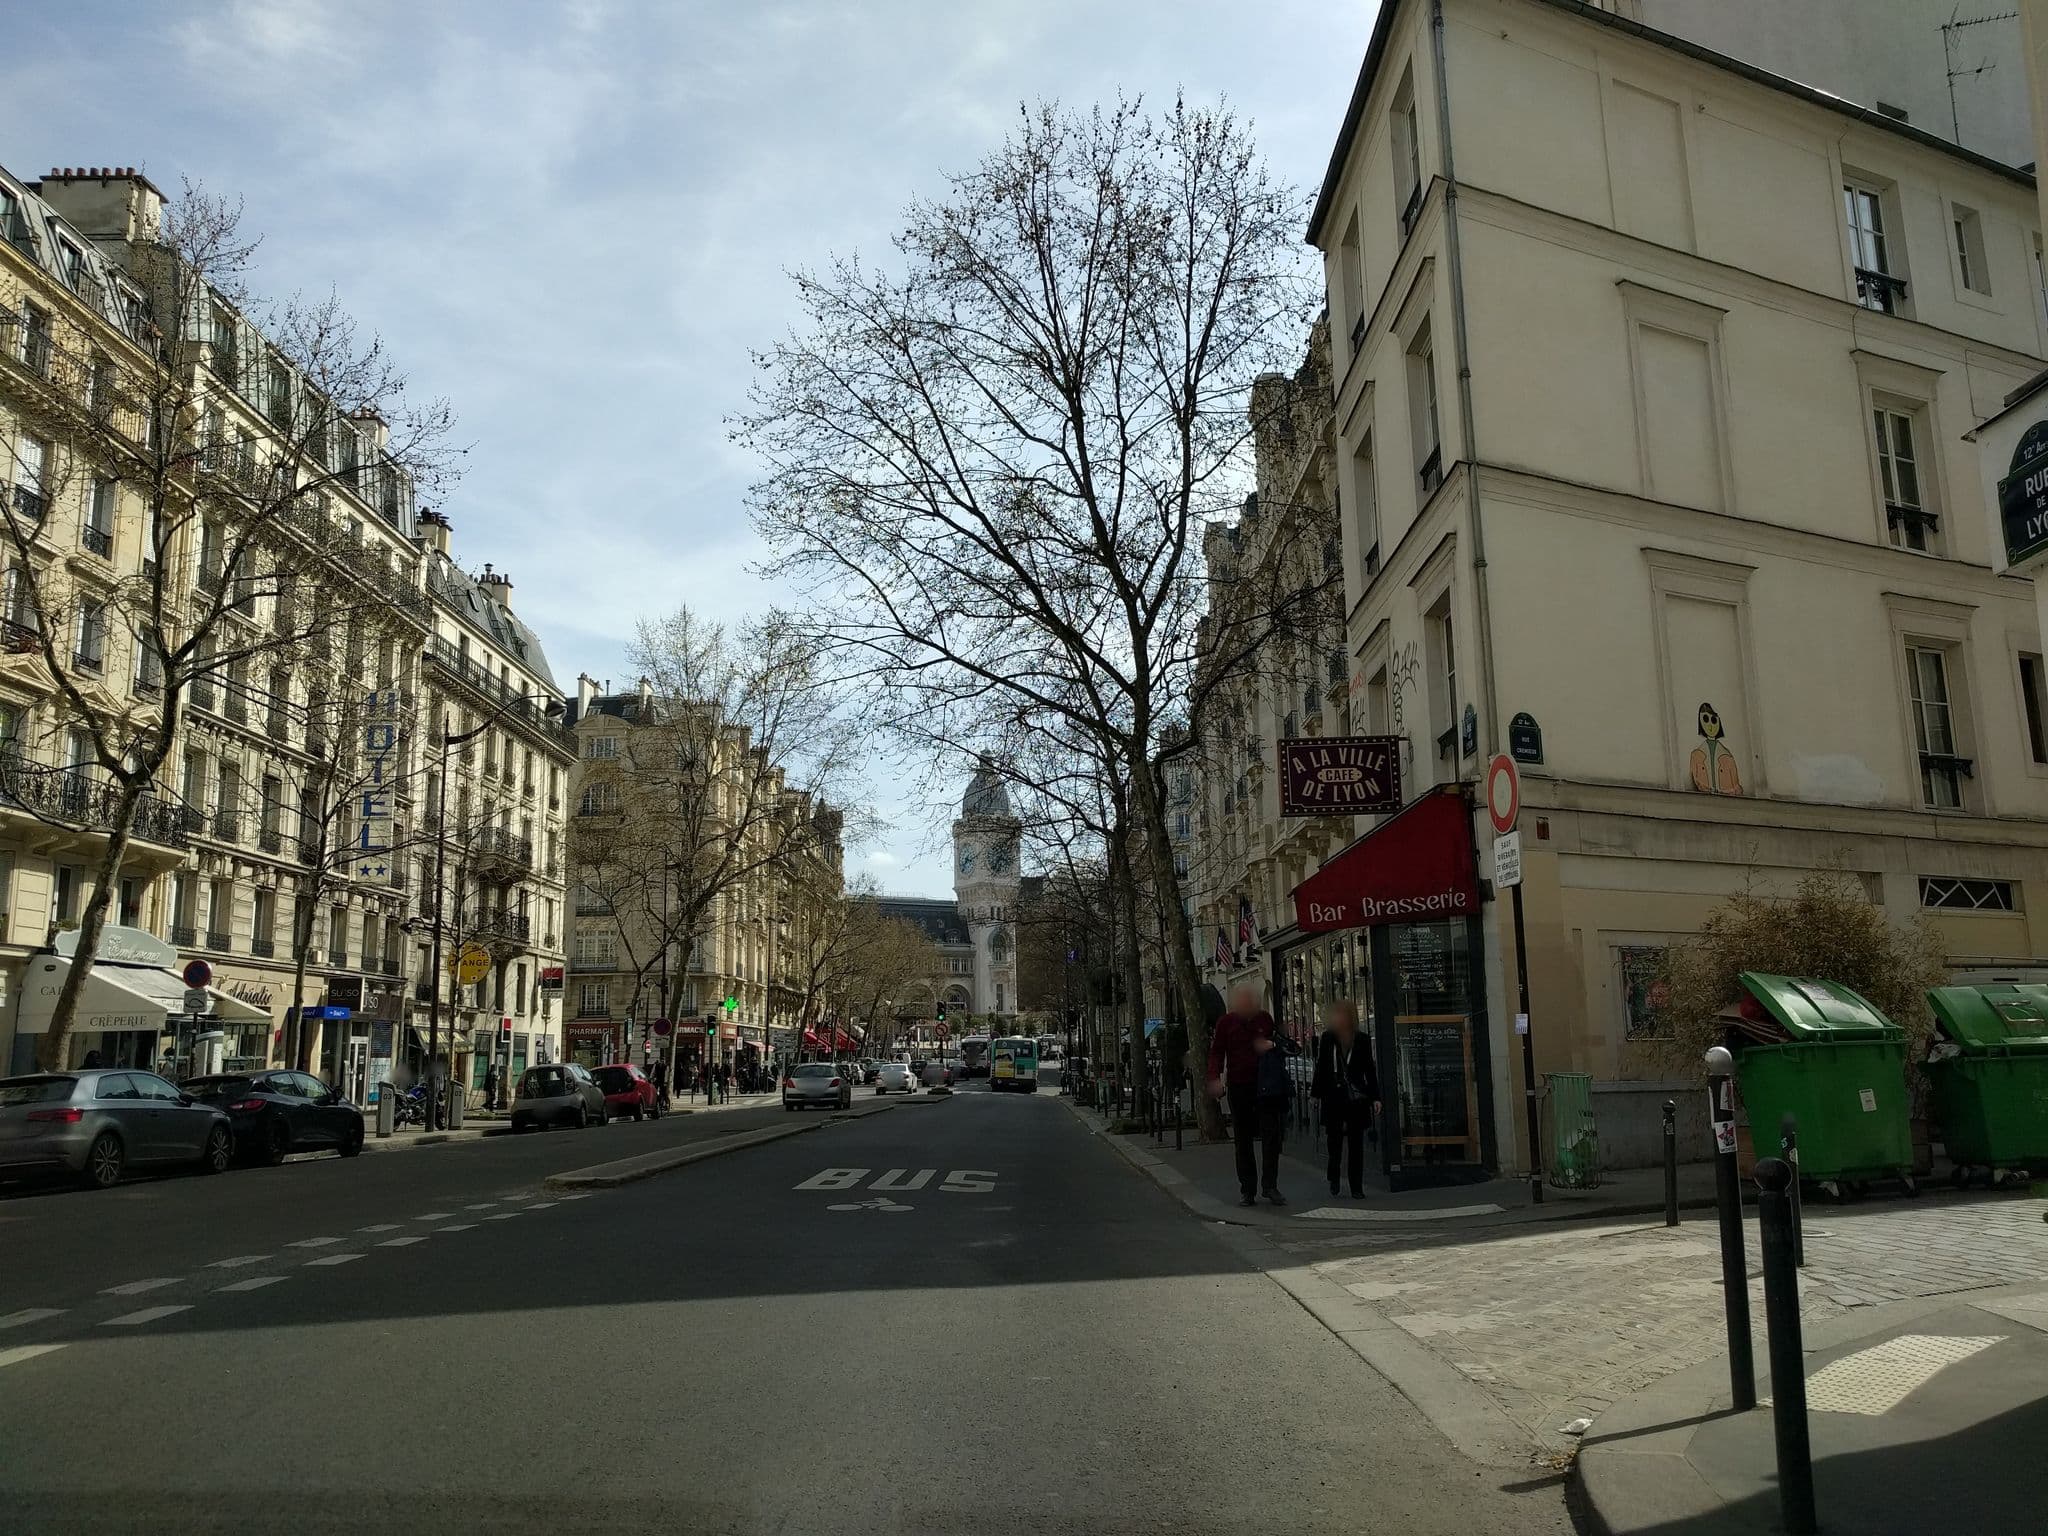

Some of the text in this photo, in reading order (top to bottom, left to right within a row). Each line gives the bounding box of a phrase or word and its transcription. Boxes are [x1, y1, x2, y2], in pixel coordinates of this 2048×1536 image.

[2036, 495, 2046, 509] DE
[1292, 747, 1386, 774] A LA VILLE
[1326, 769, 1353, 781] CAFE
[1302, 778, 1381, 802] DE LYON
[1309, 887, 1466, 923] Bar Brasserie
[448, 958, 489, 967] CANGE
[89, 1014, 148, 1027] CRÊPERIE
[792, 1168, 1000, 1193] BUS
